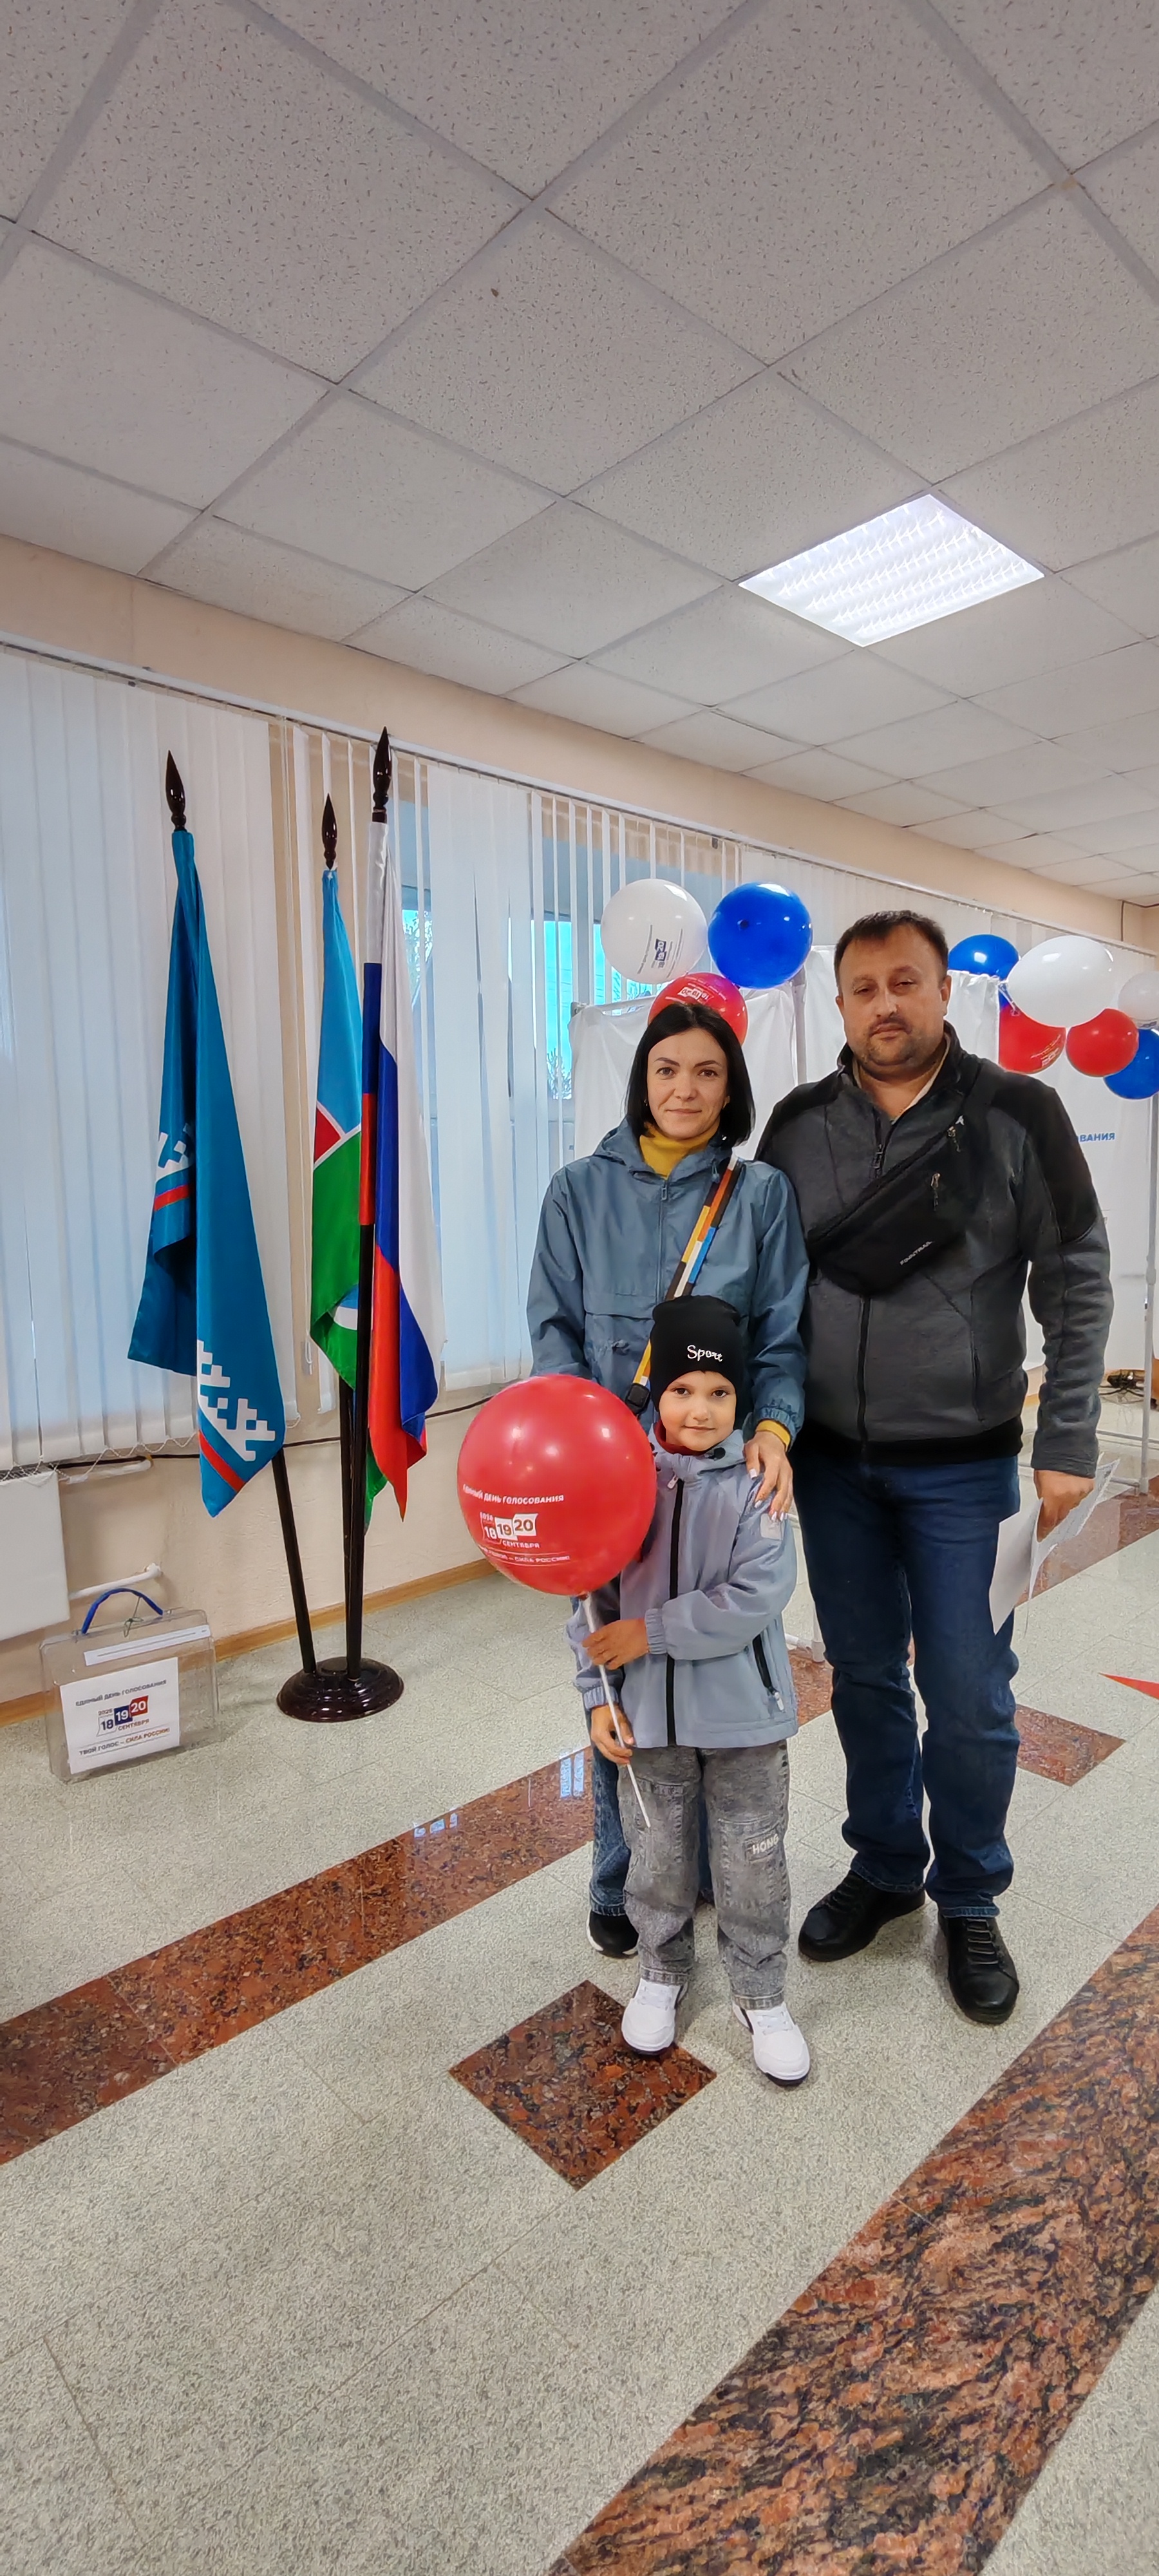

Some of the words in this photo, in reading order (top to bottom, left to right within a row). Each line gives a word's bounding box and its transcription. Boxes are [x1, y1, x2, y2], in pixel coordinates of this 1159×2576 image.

[1077, 1132, 1115, 1142] ВАНИЯ
[484, 1493, 502, 1504] ДЕНЬ
[502, 1495, 564, 1504] ГОЛОСОВАНИЯ
[484, 1526, 497, 1539] 18
[497, 1524, 512, 1536] 19
[514, 1519, 534, 1531] 20
[502, 1540, 540, 1548] СЕНТЯБРЯ
[76, 1695, 103, 1706] ЕДИНЫЙ
[104, 1692, 120, 1700] ДЕНЬ
[122, 1680, 167, 1695] ГОЛОСОВАНИЯ
[101, 1719, 113, 1730] 18
[116, 1710, 128, 1721] 19
[131, 1701, 146, 1713] 20
[118, 1719, 149, 1731] СЕНТЯБРЯ
[79, 1747, 97, 1756] ТВОЙ
[98, 1741, 120, 1751] ГОЛОС
[126, 1735, 142, 1743] СИЛА
